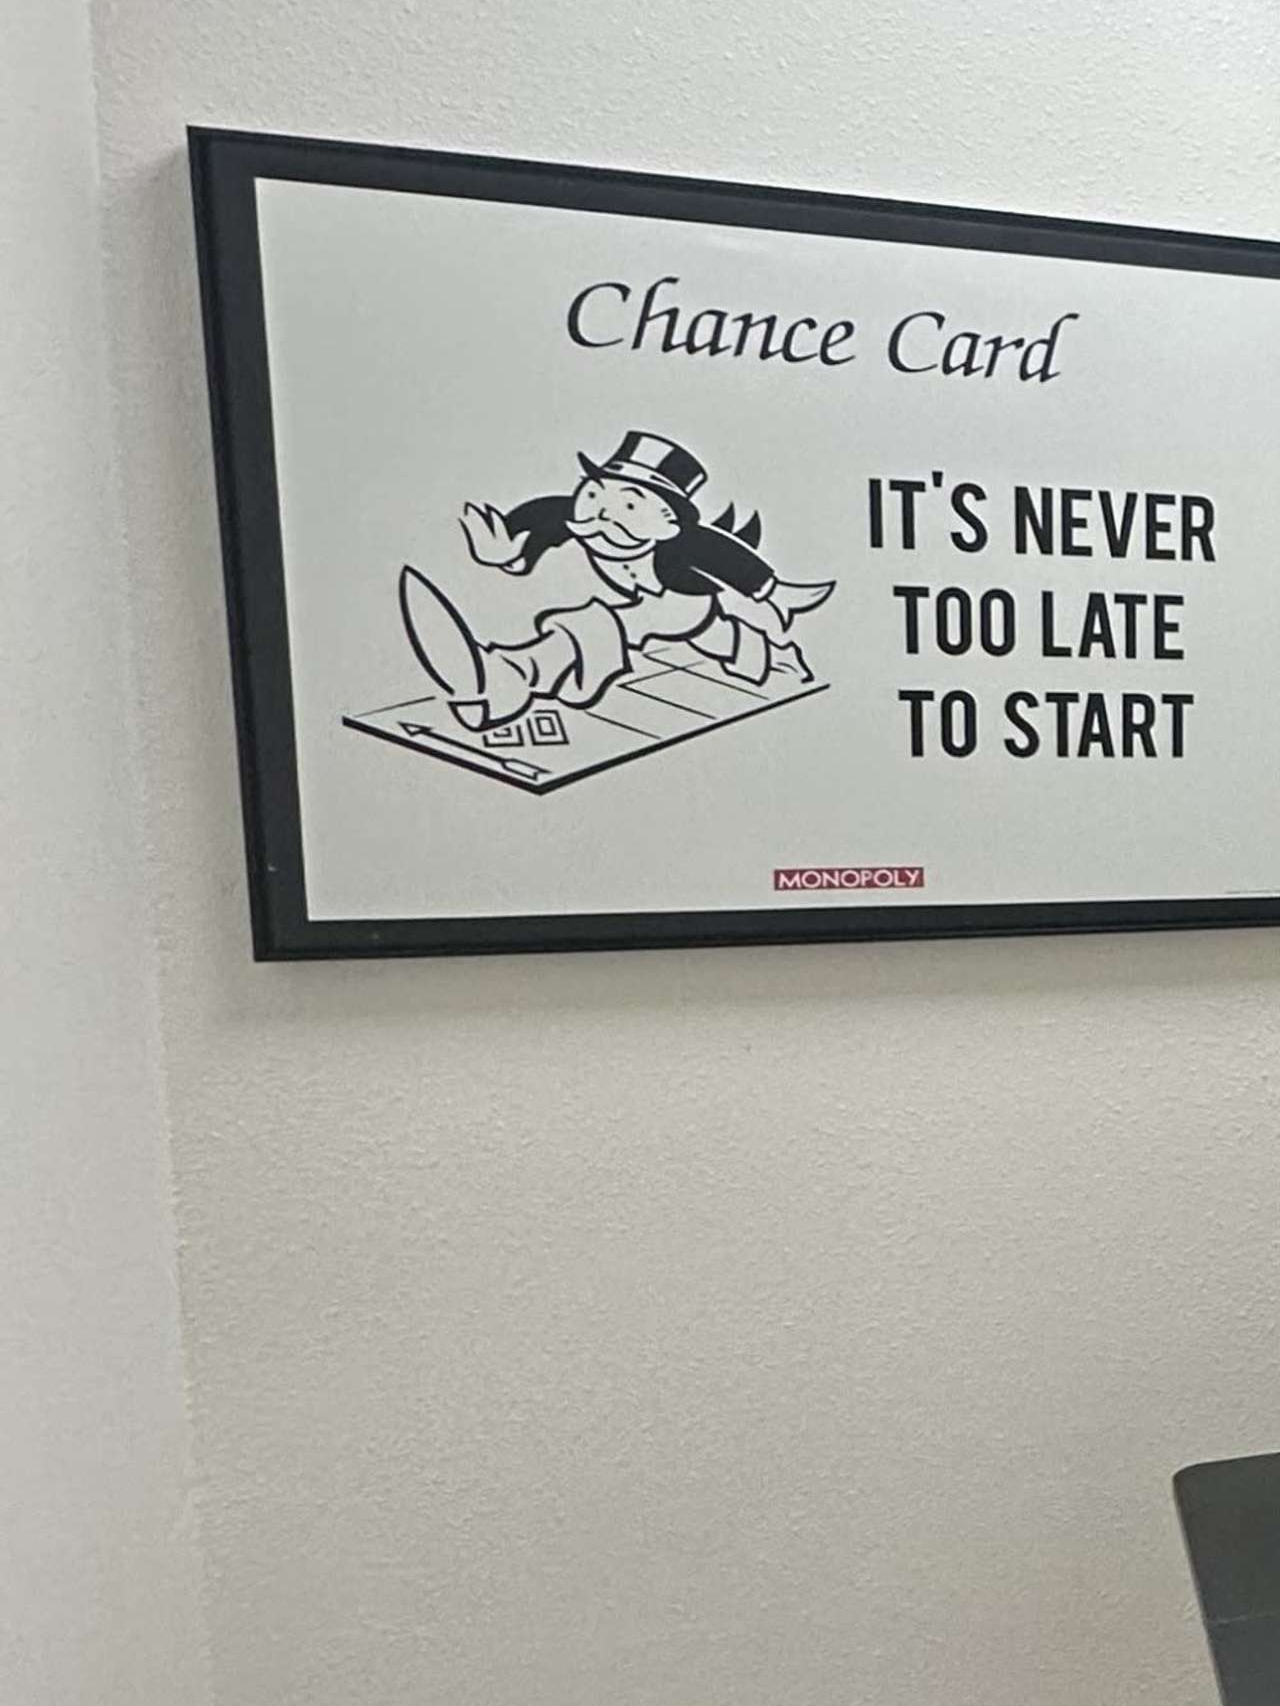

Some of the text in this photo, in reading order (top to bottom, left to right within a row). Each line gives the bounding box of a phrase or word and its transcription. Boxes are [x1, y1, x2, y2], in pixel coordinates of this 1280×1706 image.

[566, 276, 1080, 384] Chance Card
[868, 471, 1216, 563] IT'S NEVER
[892, 585, 1185, 661] TOO LATE
[897, 689, 1195, 759] TO START
[778, 869, 920, 889] MONOPOLY
